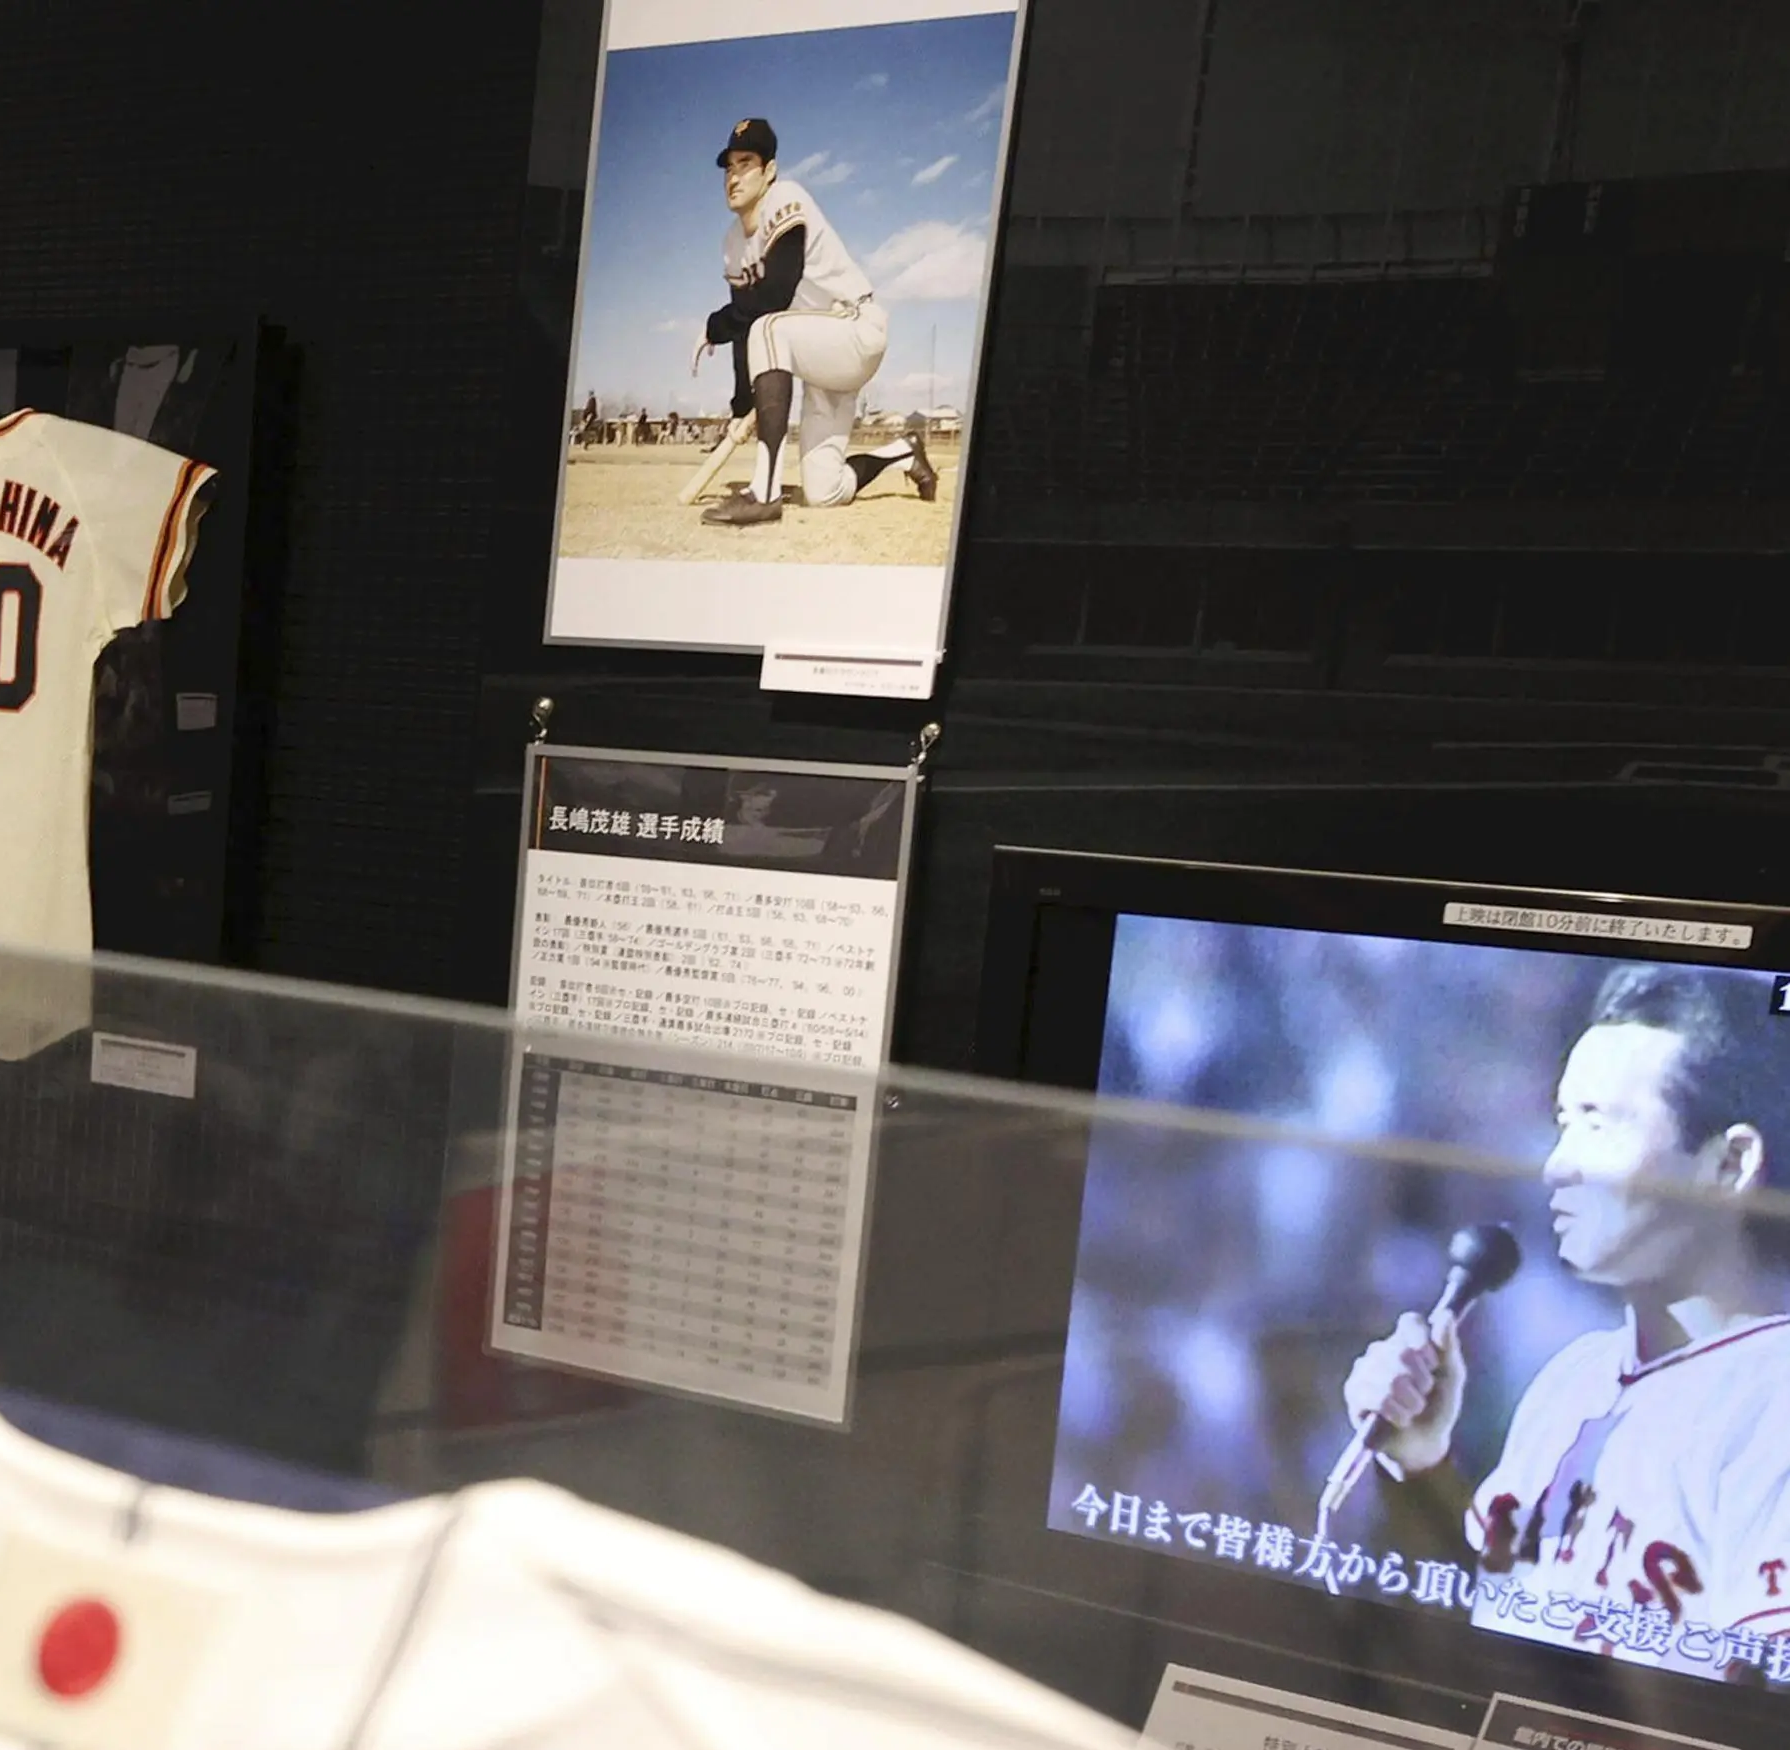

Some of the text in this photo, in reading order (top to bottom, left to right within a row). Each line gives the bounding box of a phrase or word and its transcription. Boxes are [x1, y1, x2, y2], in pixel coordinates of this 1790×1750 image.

[549, 805, 727, 844] 長嶋茂雄 選手成績
